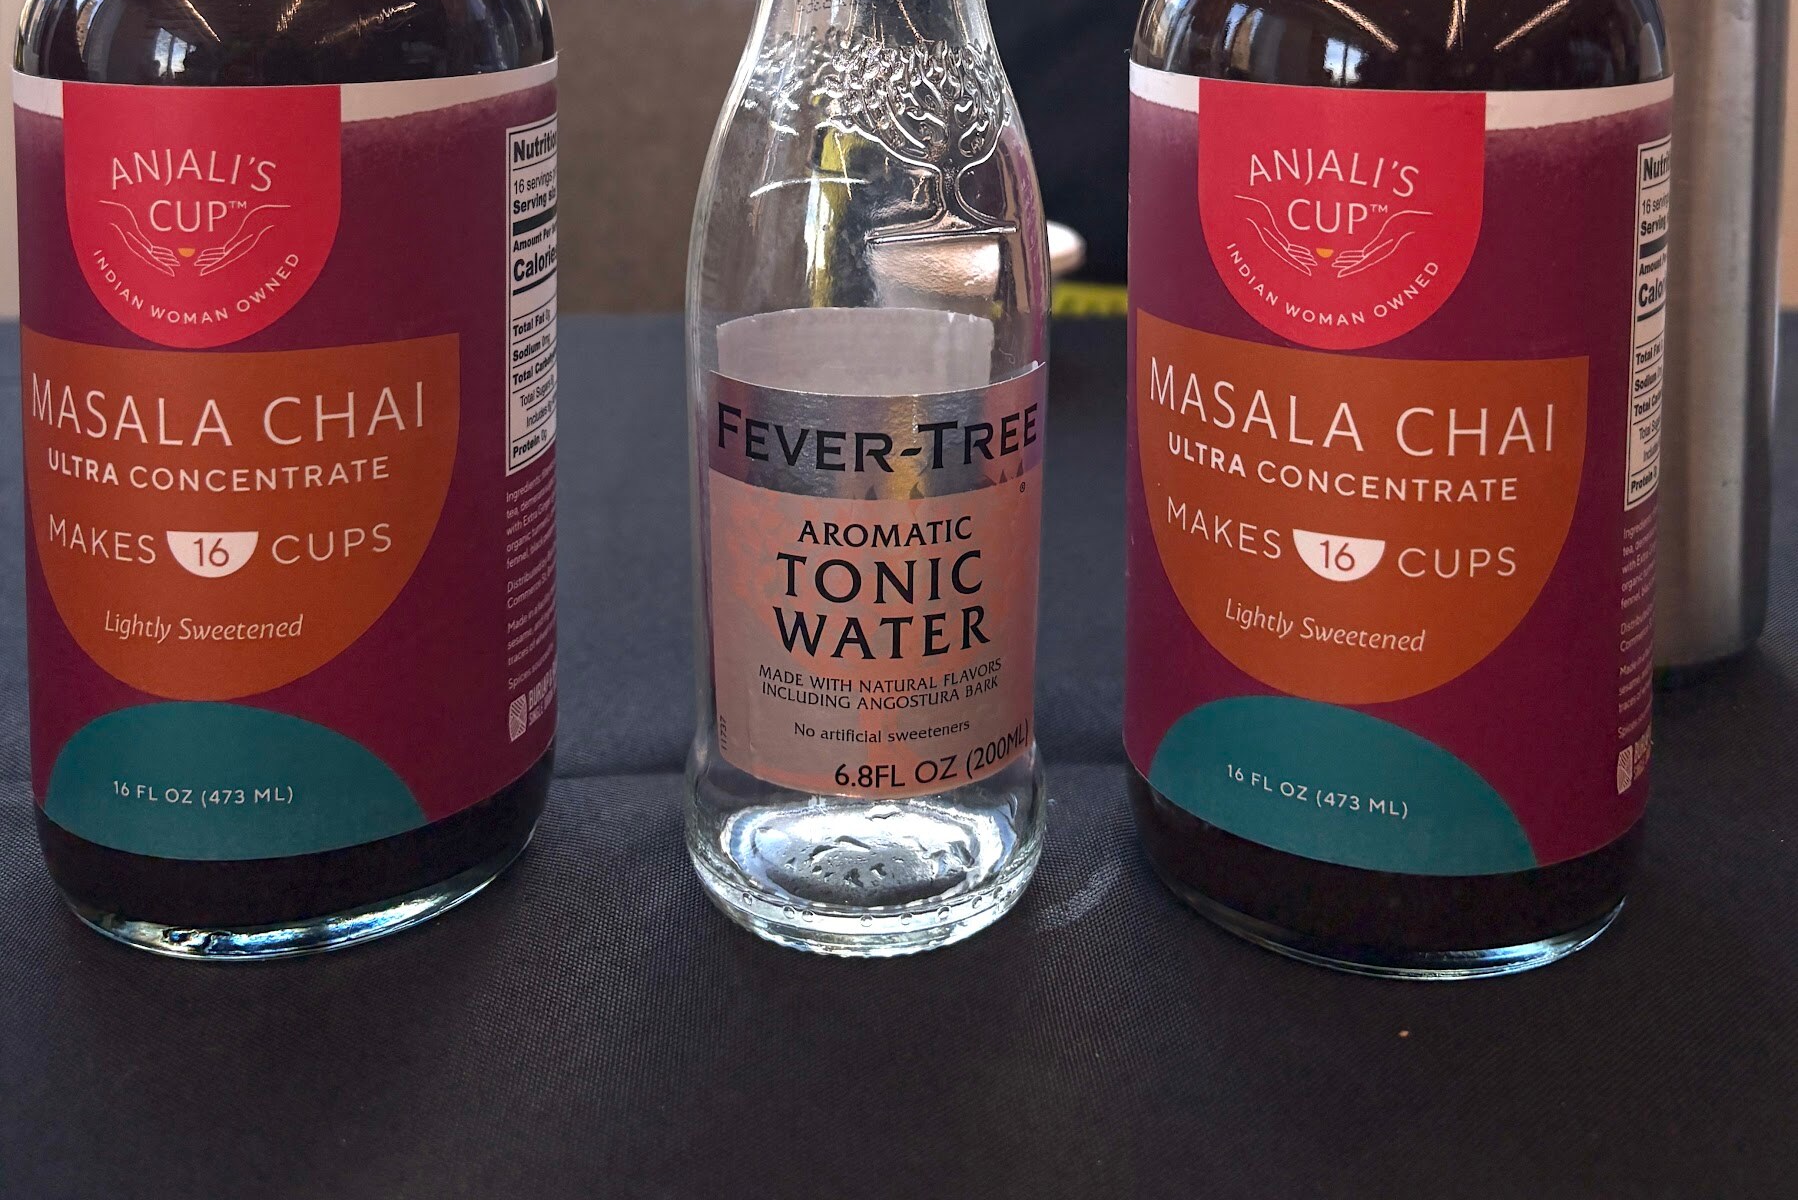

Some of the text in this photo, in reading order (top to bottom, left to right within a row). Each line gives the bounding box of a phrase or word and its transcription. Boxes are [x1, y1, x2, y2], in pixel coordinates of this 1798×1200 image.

[112, 148, 276, 192] ANJALI'S
[514, 177, 525, 195] 16
[526, 170, 552, 192] servings
[1249, 148, 1419, 198] ANJALI'S
[513, 193, 547, 215] Serving
[1642, 199, 1651, 215] 16
[513, 231, 542, 253] Amount
[1640, 214, 1666, 237] Serving
[1639, 256, 1662, 277] Amount
[93, 249, 299, 325] INDIAN WOMAN OWNED
[1226, 243, 1439, 327] INDIAN WOMAN OWNED
[513, 318, 533, 337] Total
[535, 312, 545, 328] Fat
[513, 340, 541, 362] Sodium
[1635, 347, 1653, 366] Total
[513, 365, 533, 385] Total
[31, 372, 425, 447] MASALA CHAI
[520, 389, 535, 407] Total
[1149, 356, 1554, 457] MASALA CHAI
[1634, 397, 1651, 418] Total
[513, 434, 541, 459] Protein
[718, 401, 1038, 473] FEVER-TREE
[47, 447, 391, 493] ULTRA CONCENTRATE
[1168, 431, 1519, 503] ULTRA CONCENTRATE
[1631, 470, 1653, 494] Protein
[49, 514, 393, 568] MAKES 16 CUPS
[797, 515, 973, 548] AROMATIC
[1167, 496, 1517, 579] MAKES 16 CUPS
[776, 549, 983, 605] TONIC
[104, 610, 304, 642] Lightly Sweetened
[507, 614, 528, 635] Made
[772, 604, 991, 661] WATER
[1224, 597, 1426, 652] Lightly Sweetened
[758, 657, 1002, 693] MADE WITH NATURAL FLAVORS
[762, 674, 999, 710] INCLUDING ANGOSTURA BARK
[794, 720, 970, 744] No artificial sweeteners
[834, 718, 1029, 789] 6.8FL OZ (200ML)
[113, 780, 294, 808] 16 FL OZ (473 ML)
[1227, 764, 1408, 820] 16 FL OZ (473 ML)
